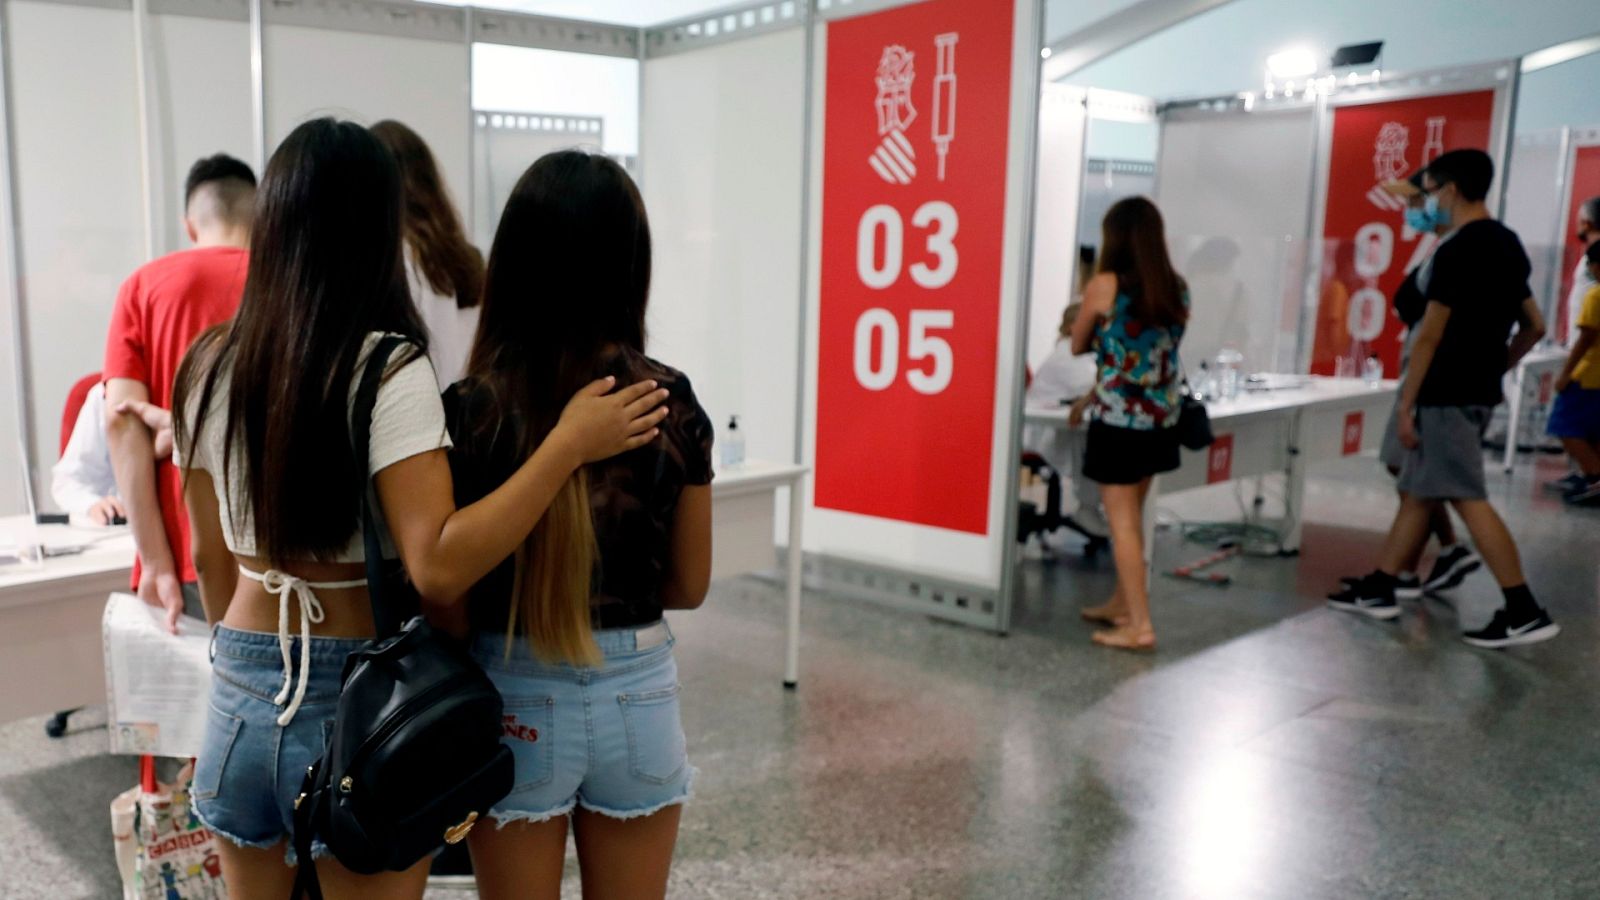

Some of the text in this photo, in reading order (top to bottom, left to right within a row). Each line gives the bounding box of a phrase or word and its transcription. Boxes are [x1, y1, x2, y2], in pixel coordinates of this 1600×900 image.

[856, 200, 959, 290] 03
[852, 307, 954, 395] 05
[1346, 287, 1409, 342] 0
